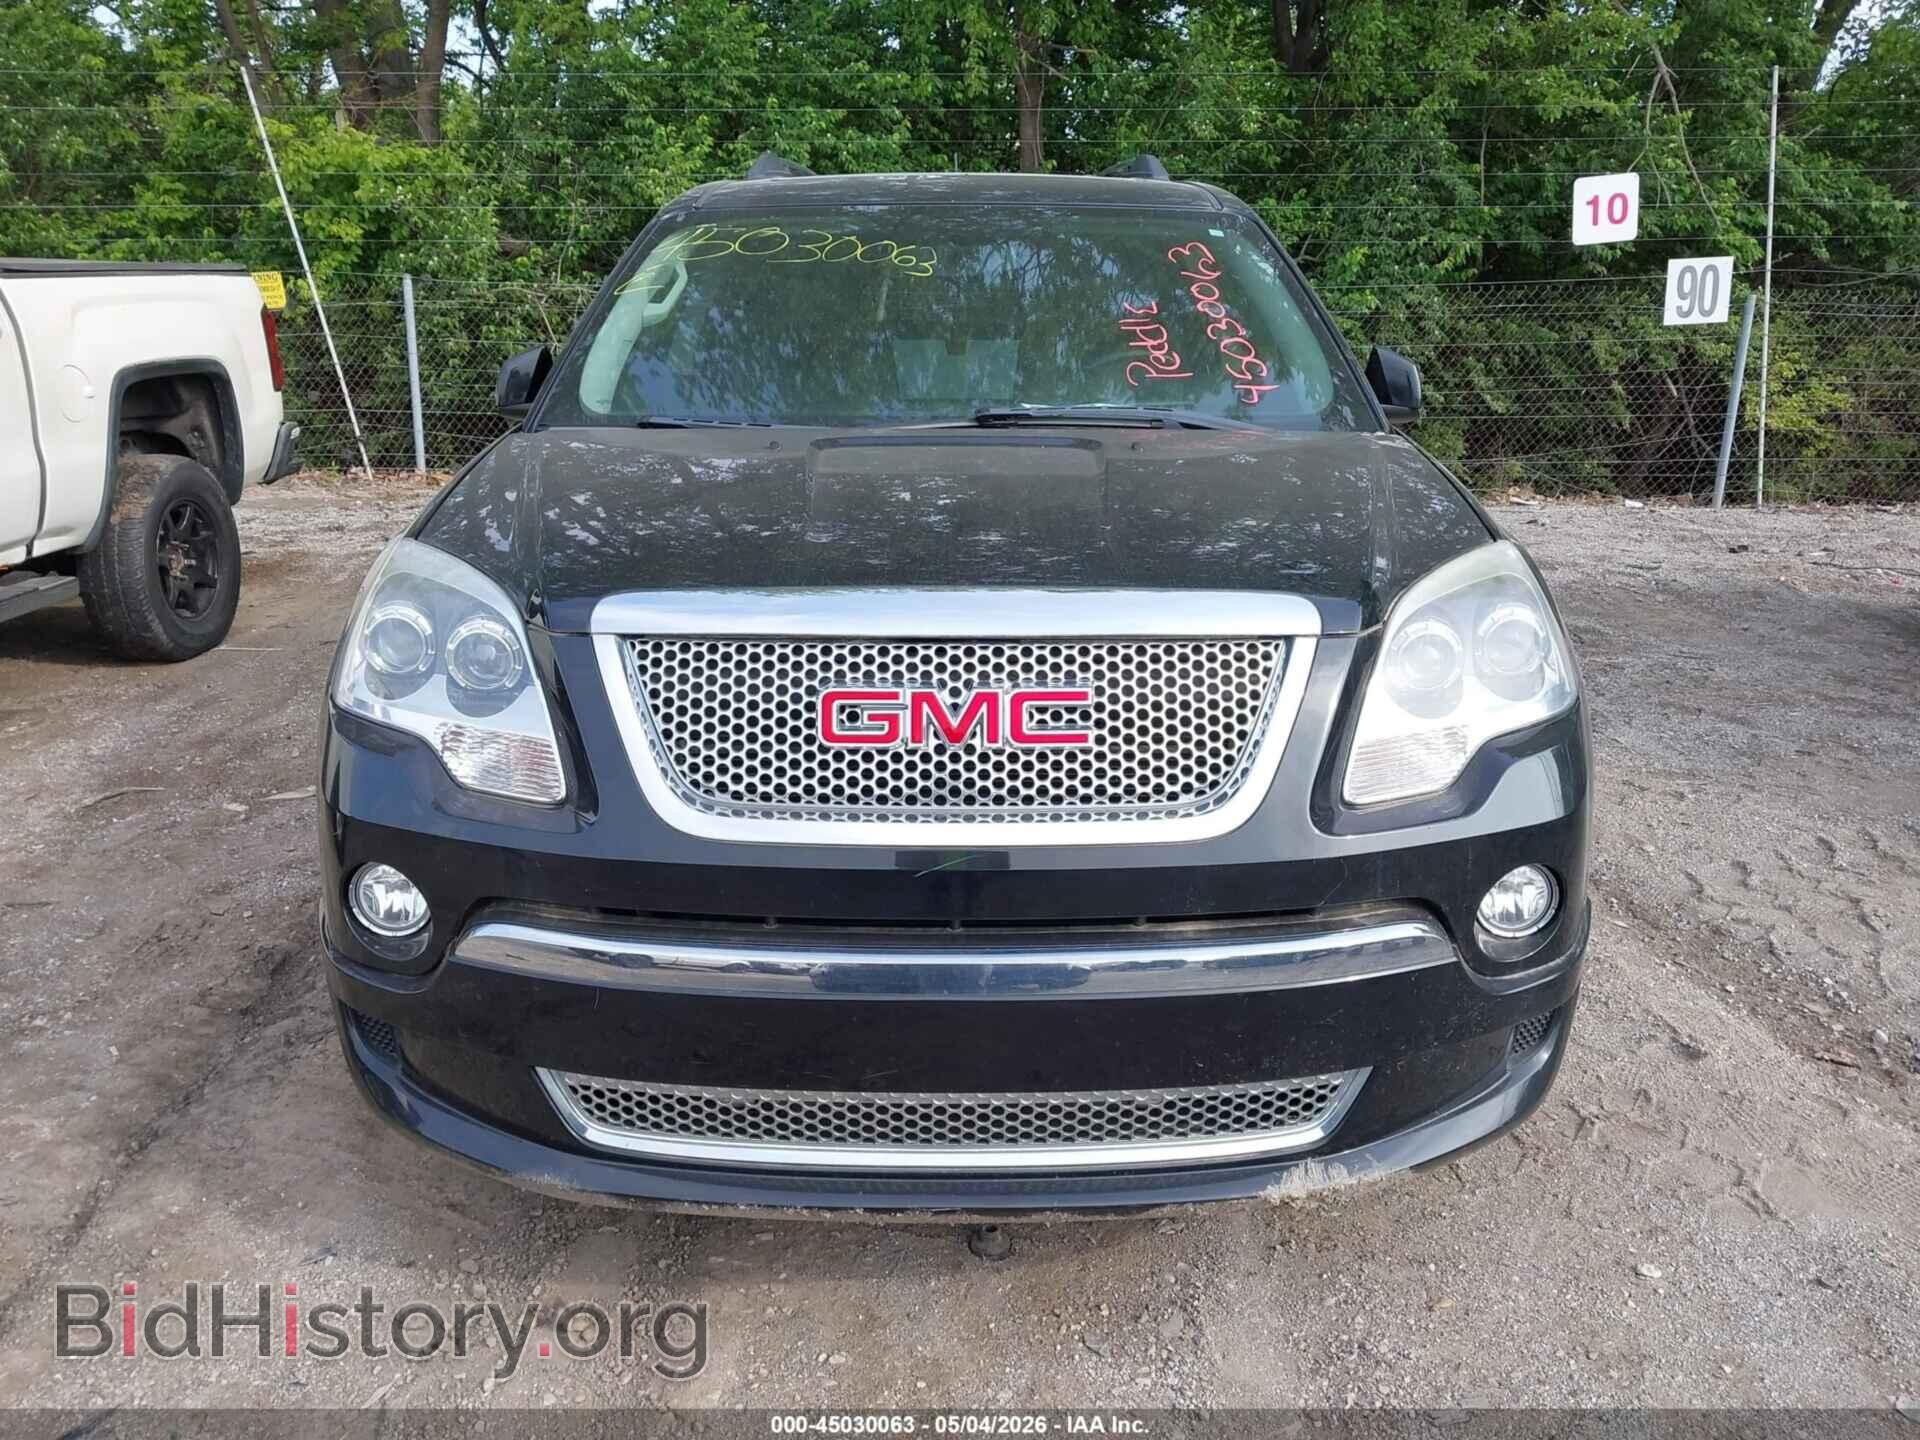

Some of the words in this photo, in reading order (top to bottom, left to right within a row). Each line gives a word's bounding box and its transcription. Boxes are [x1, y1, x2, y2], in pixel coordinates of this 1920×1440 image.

[1586, 192, 1629, 226] 10
[1676, 264, 1720, 318] 90
[1167, 241, 1281, 404] 45030063
[818, 687, 1092, 749] GMC
